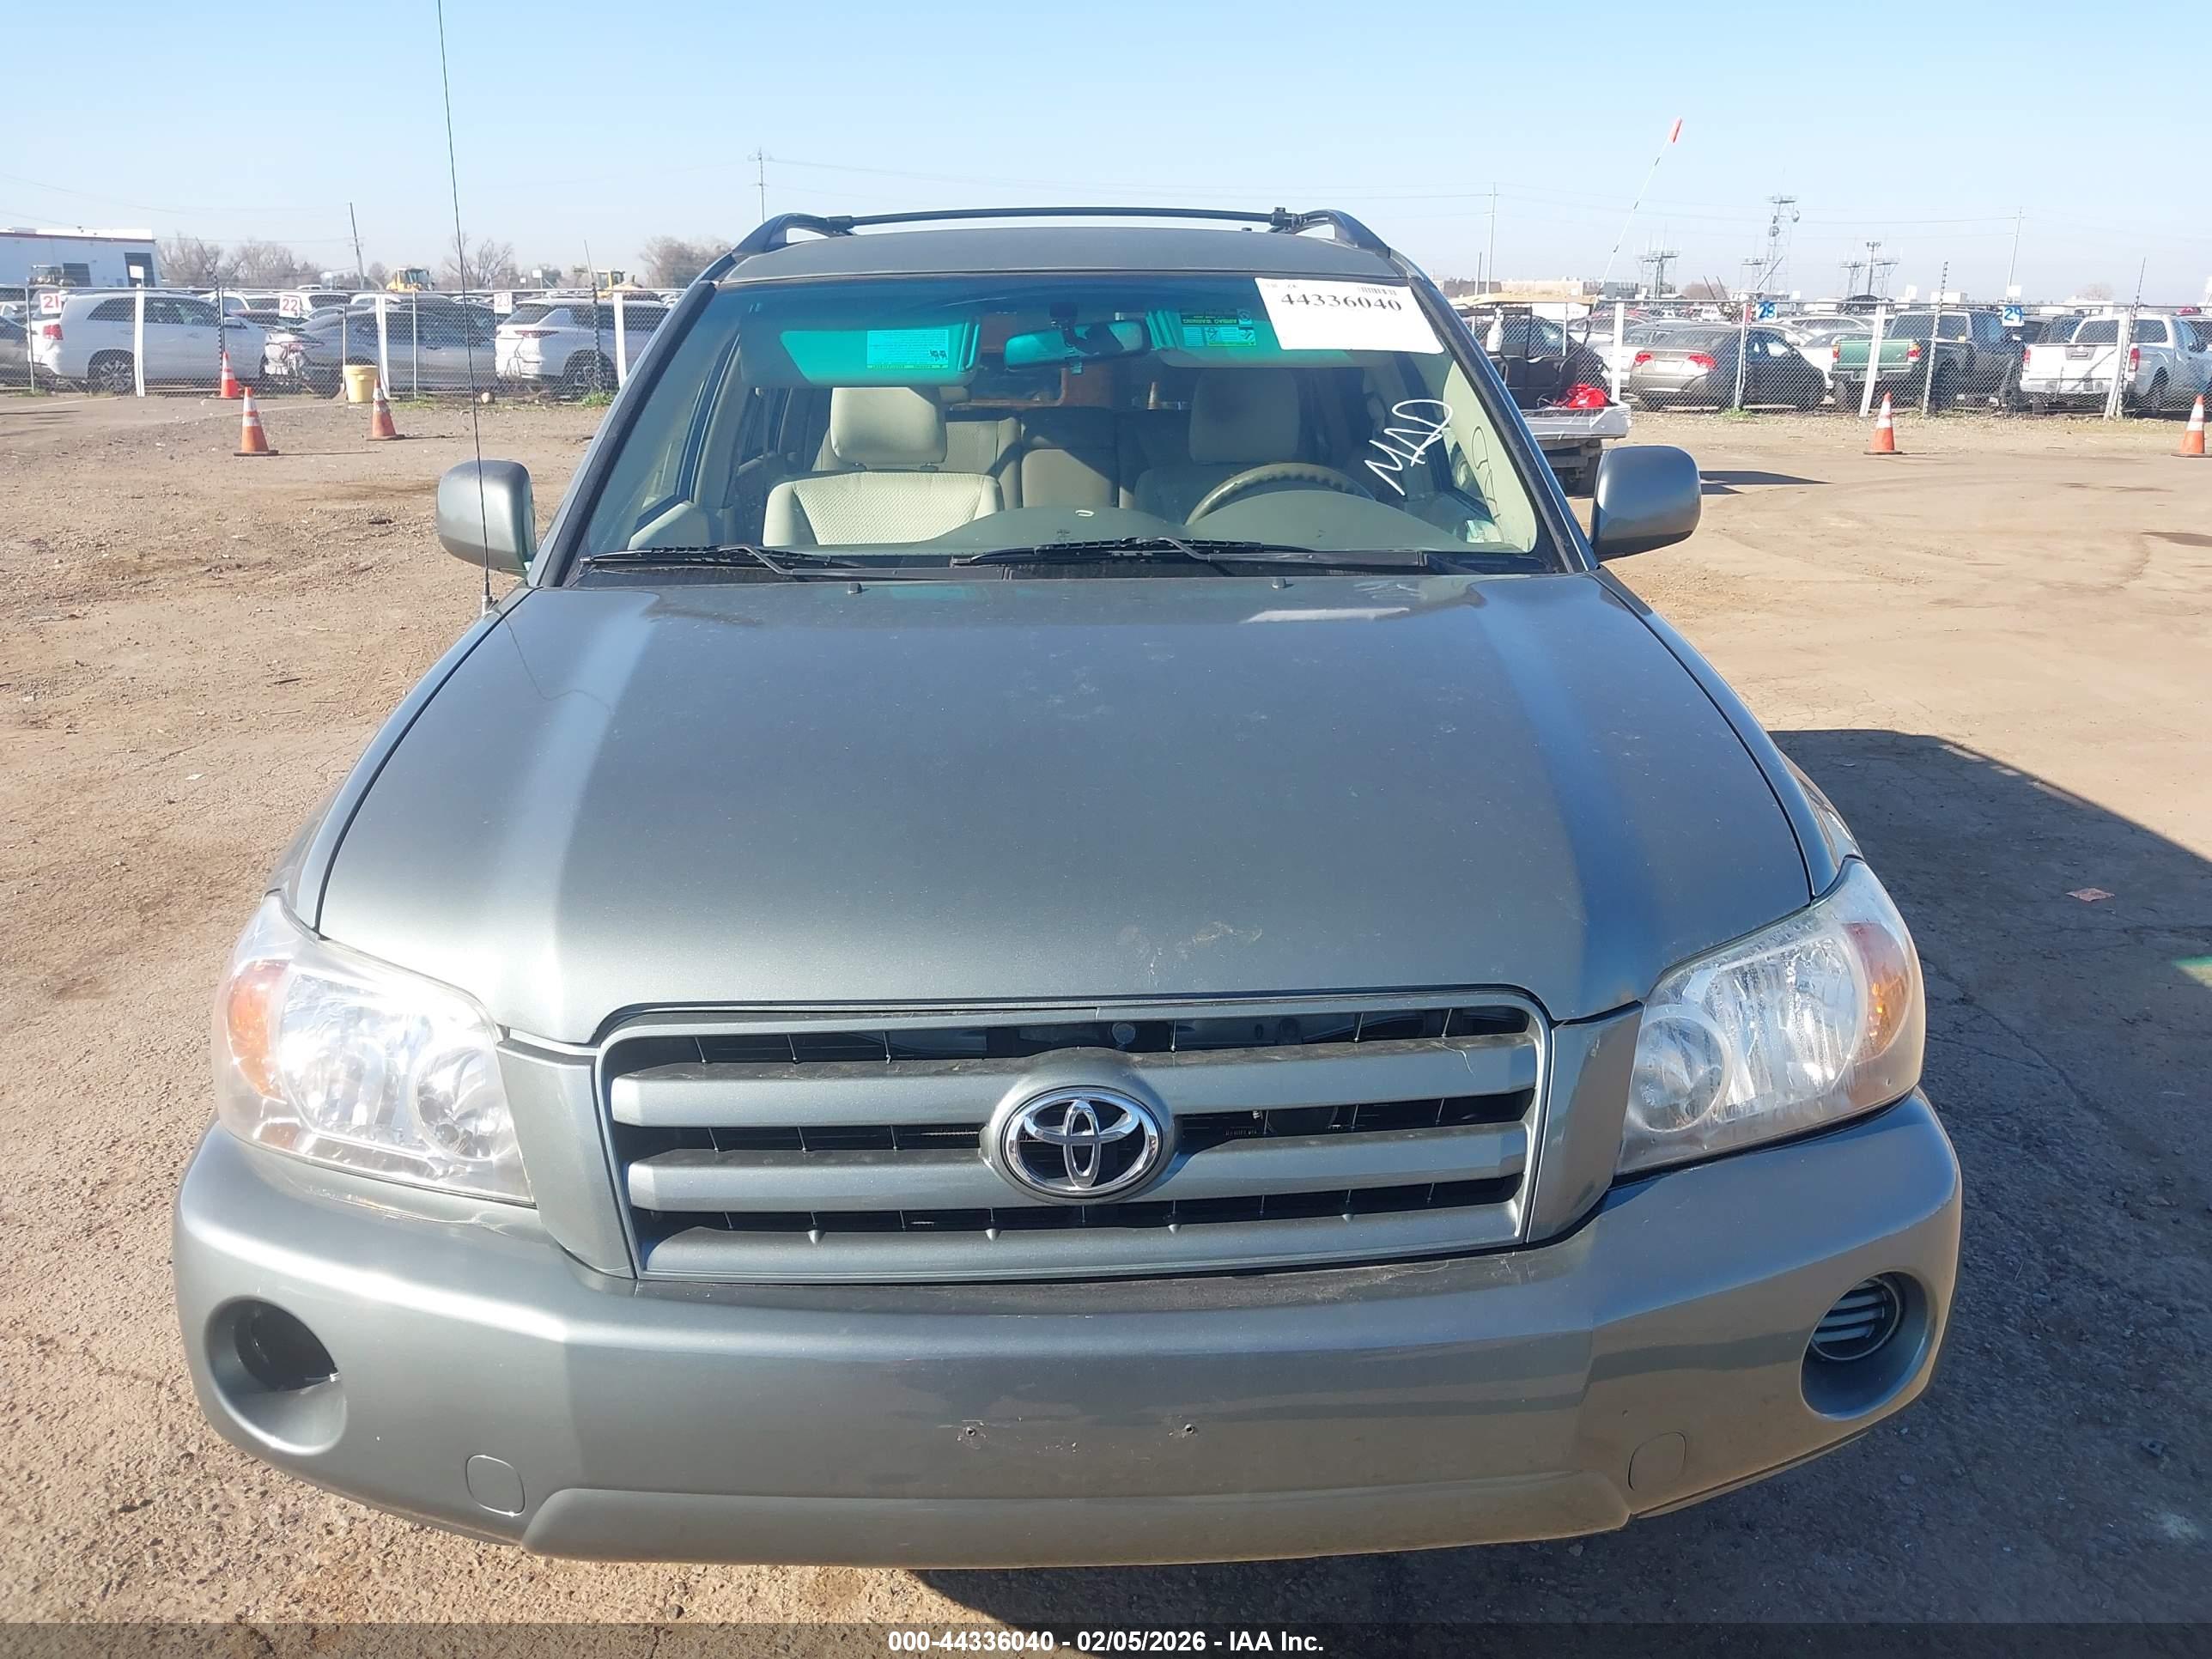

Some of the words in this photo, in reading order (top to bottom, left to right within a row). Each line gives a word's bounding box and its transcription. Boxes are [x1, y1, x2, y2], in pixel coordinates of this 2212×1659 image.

[43, 295, 59, 309] 21
[282, 298, 298, 313] 22
[496, 294, 510, 307] 23
[1280, 294, 1403, 312] 44336040
[1758, 301, 1777, 319] 28
[2003, 305, 2023, 323] 29
